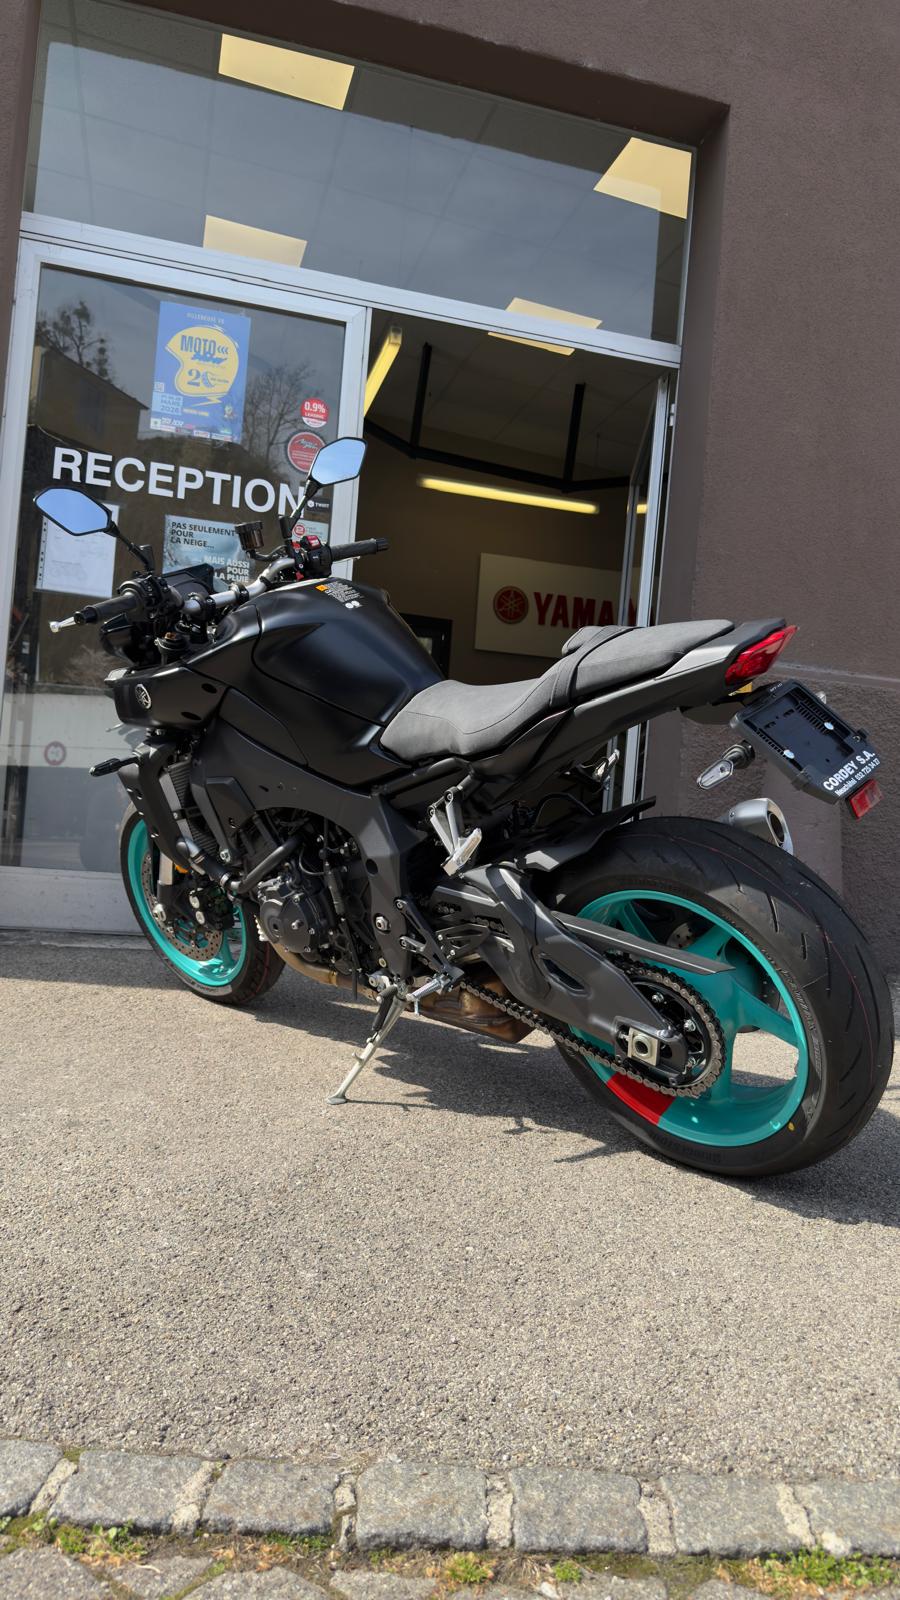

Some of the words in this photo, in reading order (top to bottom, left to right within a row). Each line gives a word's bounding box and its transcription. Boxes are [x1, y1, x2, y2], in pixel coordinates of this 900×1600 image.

[180, 335, 217, 357] MOTO
[304, 401, 326, 414] 0.9%
[52, 446, 304, 518] RECEPTION
[171, 522, 187, 530] PAS
[189, 524, 236, 537] SEULEMENT
[171, 529, 194, 538] POUR
[204, 555, 225, 565] MAIS
[226, 559, 250, 568] AUSSI
[214, 572, 225, 580] LA
[226, 573, 249, 582] PLUIE
[227, 566, 249, 576] POUR
[533, 591, 638, 628] YAMA
[823, 760, 858, 790] CORDEY
[855, 750, 876, 764] S.A.
